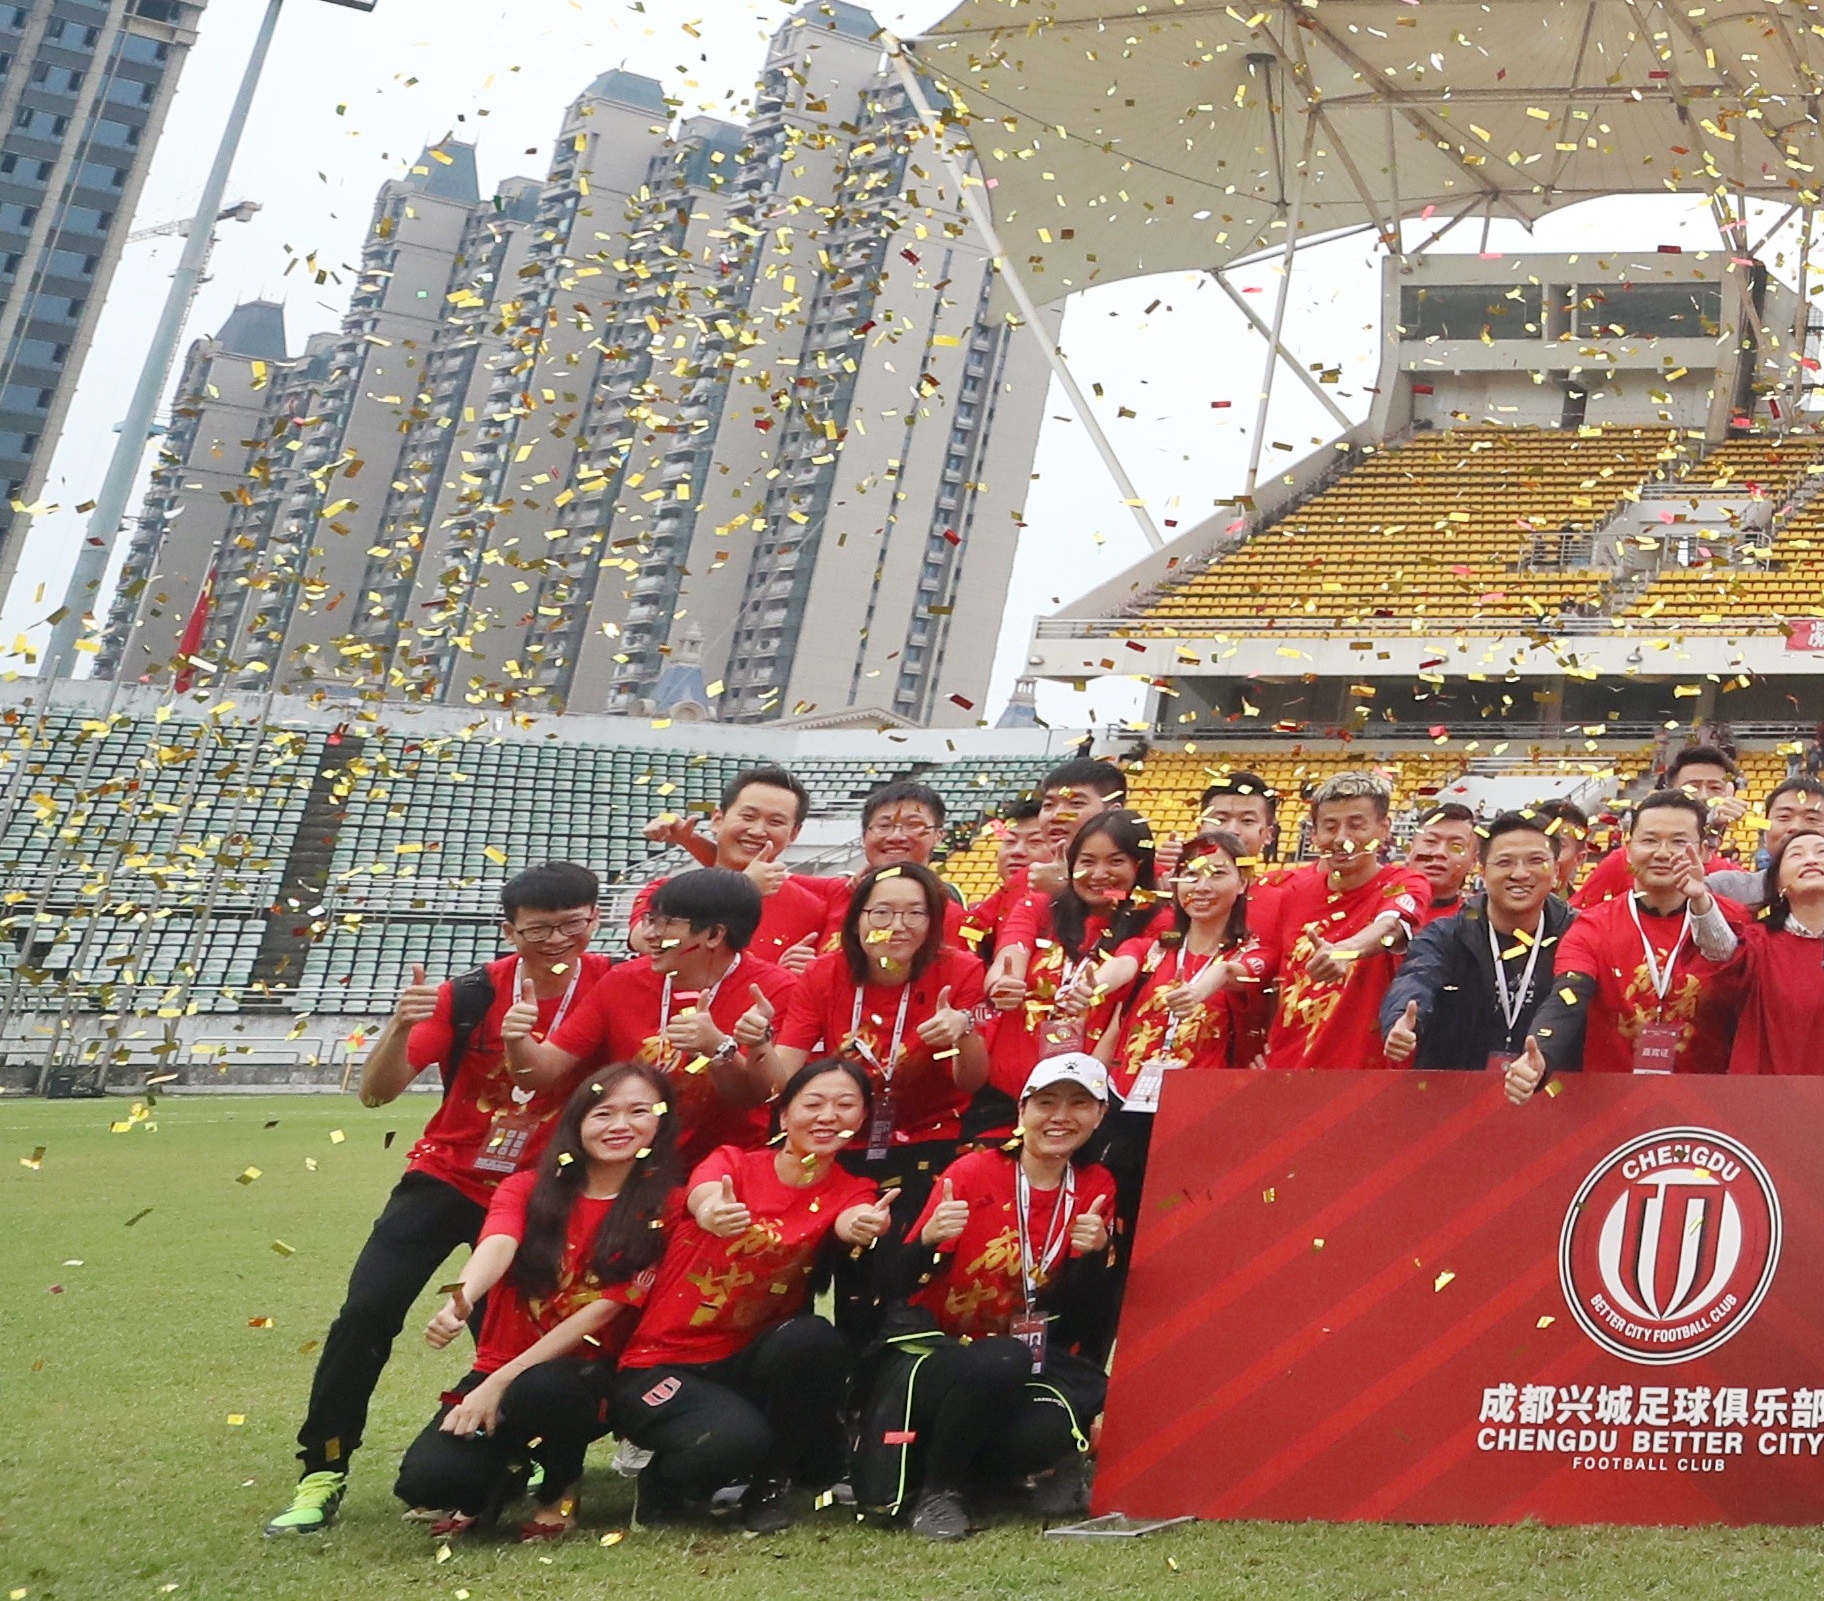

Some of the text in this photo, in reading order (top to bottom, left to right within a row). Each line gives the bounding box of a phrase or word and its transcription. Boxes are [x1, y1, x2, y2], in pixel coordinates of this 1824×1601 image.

[1622, 1144, 1741, 1182] CHENGDU
[1590, 1293, 1738, 1343] BETTER CITY FOOTBALL CLUB
[1476, 1427, 1824, 1456] CHENGDU BETTER CITY
[1572, 1456, 1726, 1473] FOOTBALL CLUB
